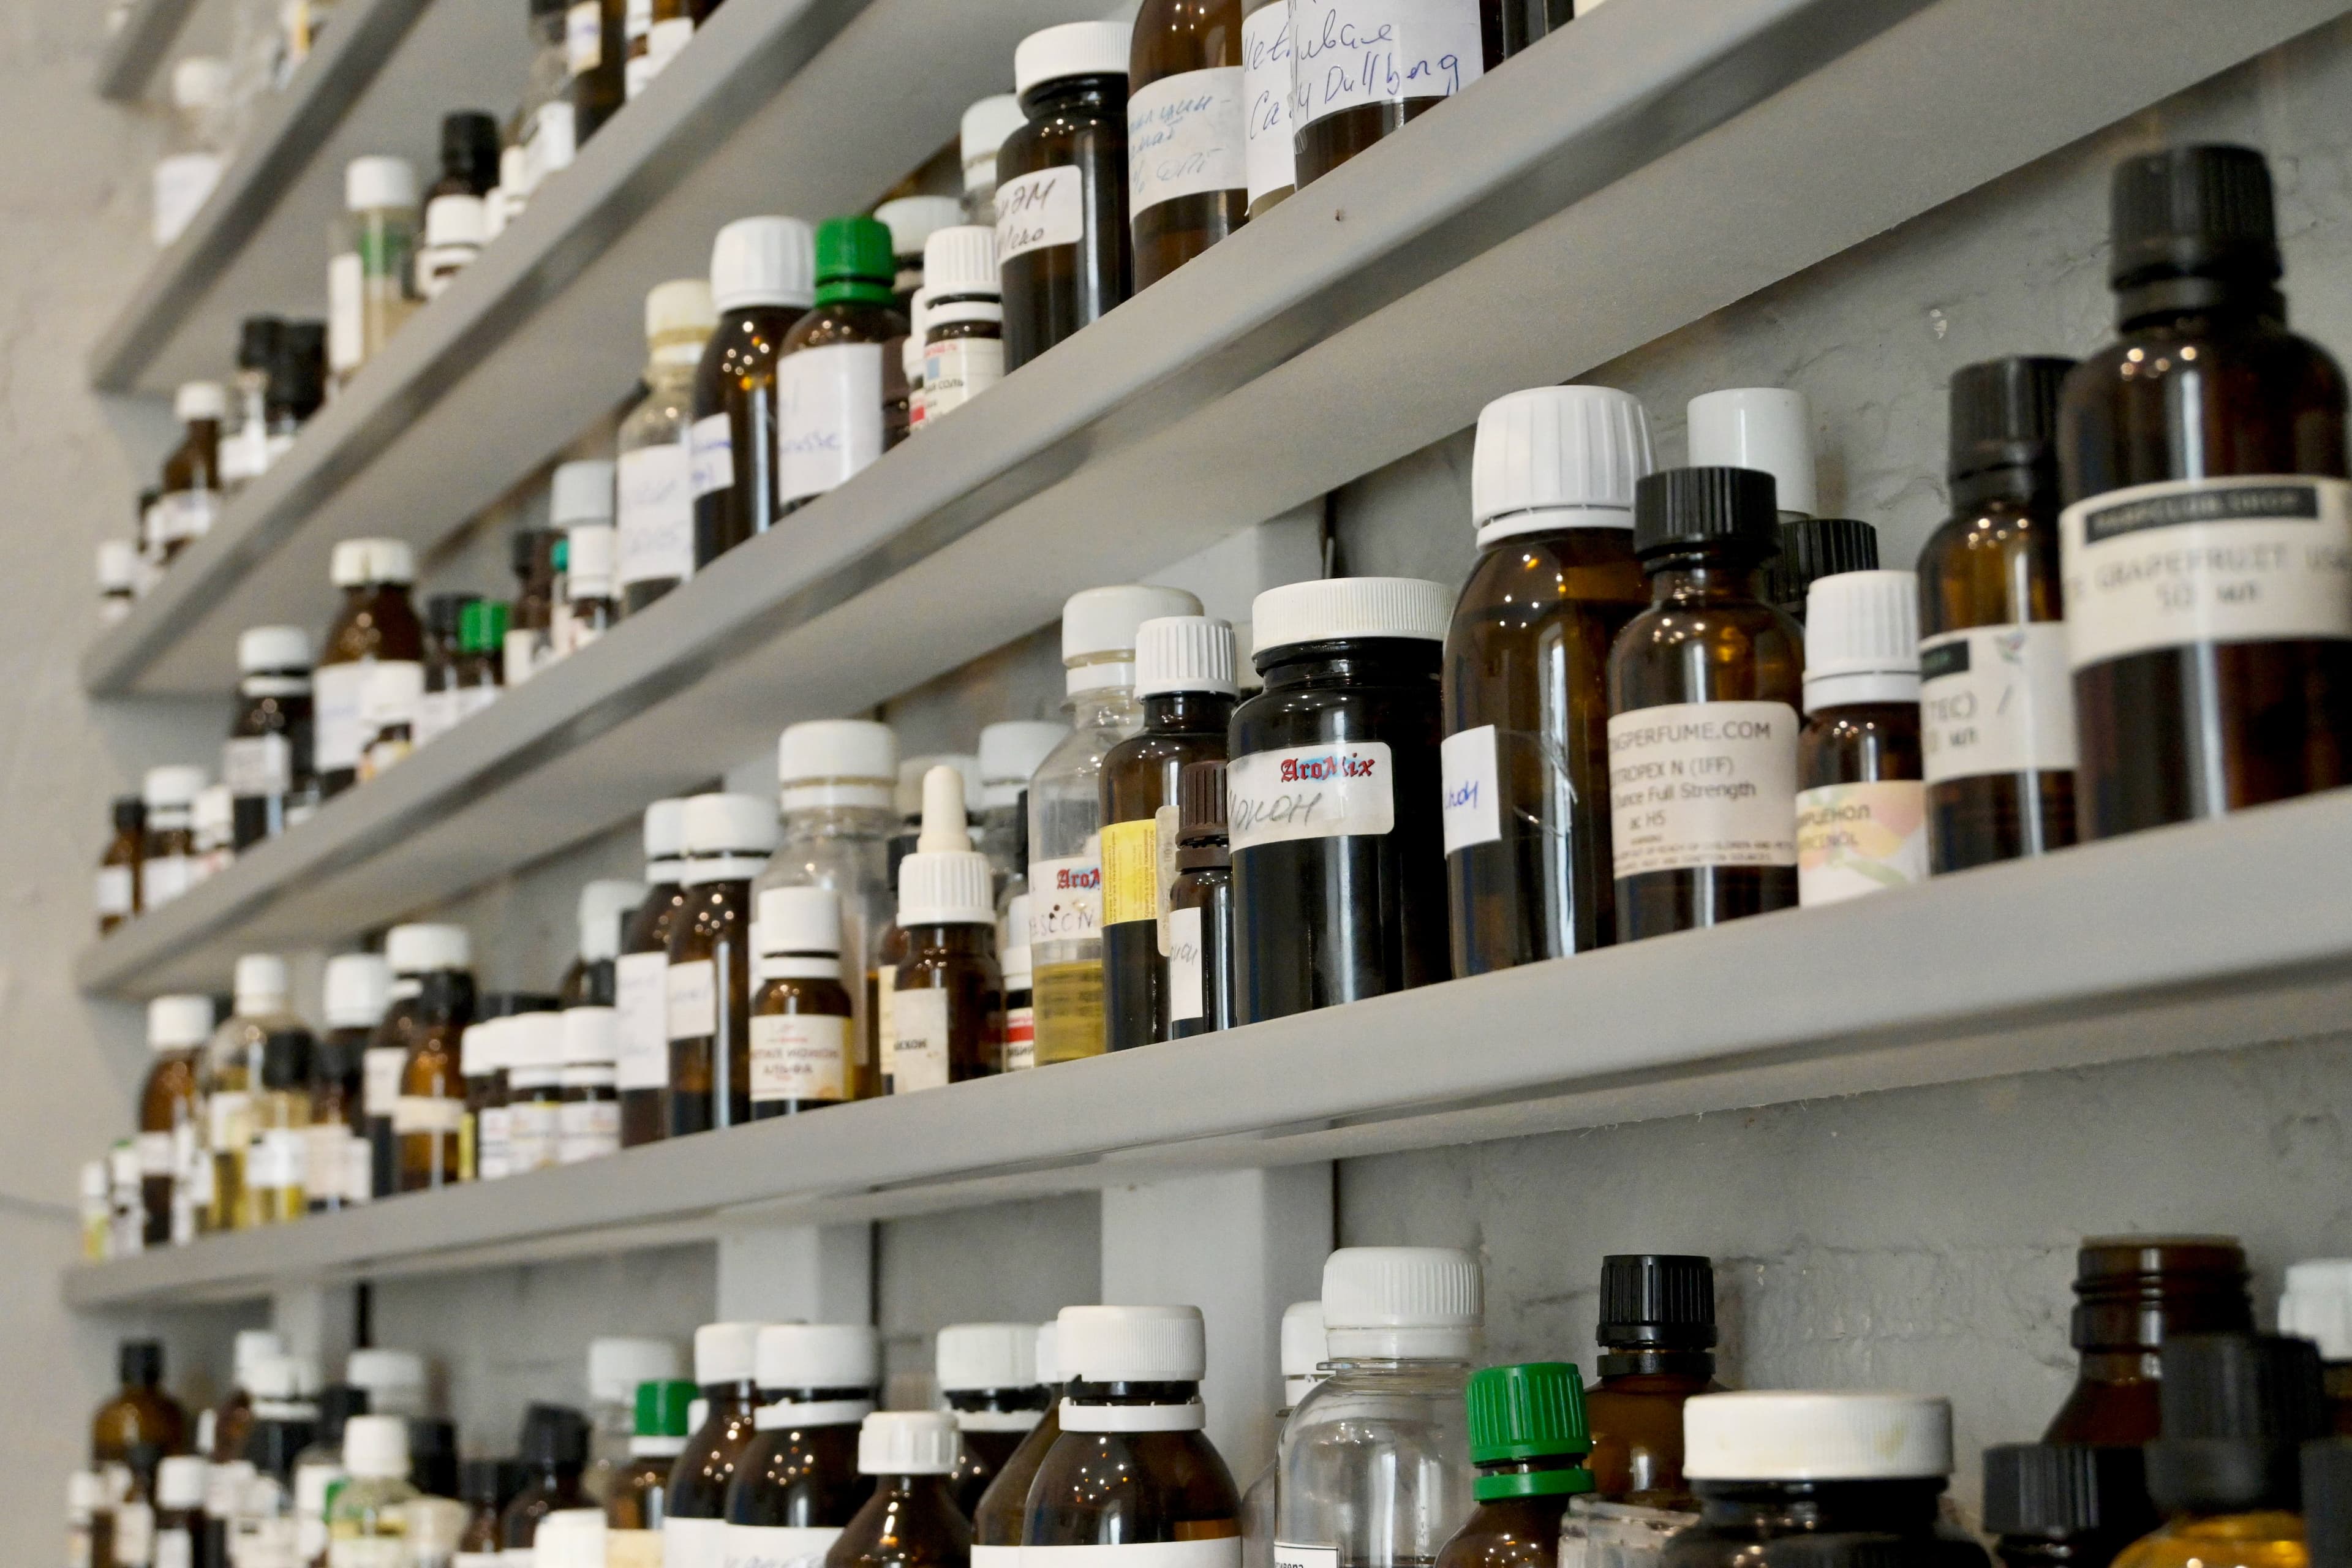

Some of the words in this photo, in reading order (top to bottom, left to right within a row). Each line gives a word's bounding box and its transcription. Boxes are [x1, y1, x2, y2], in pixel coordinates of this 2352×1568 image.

[1281, 752, 1376, 783] AroMix
[1648, 785, 1675, 802] Full
[1680, 778, 1757, 802] Strength
